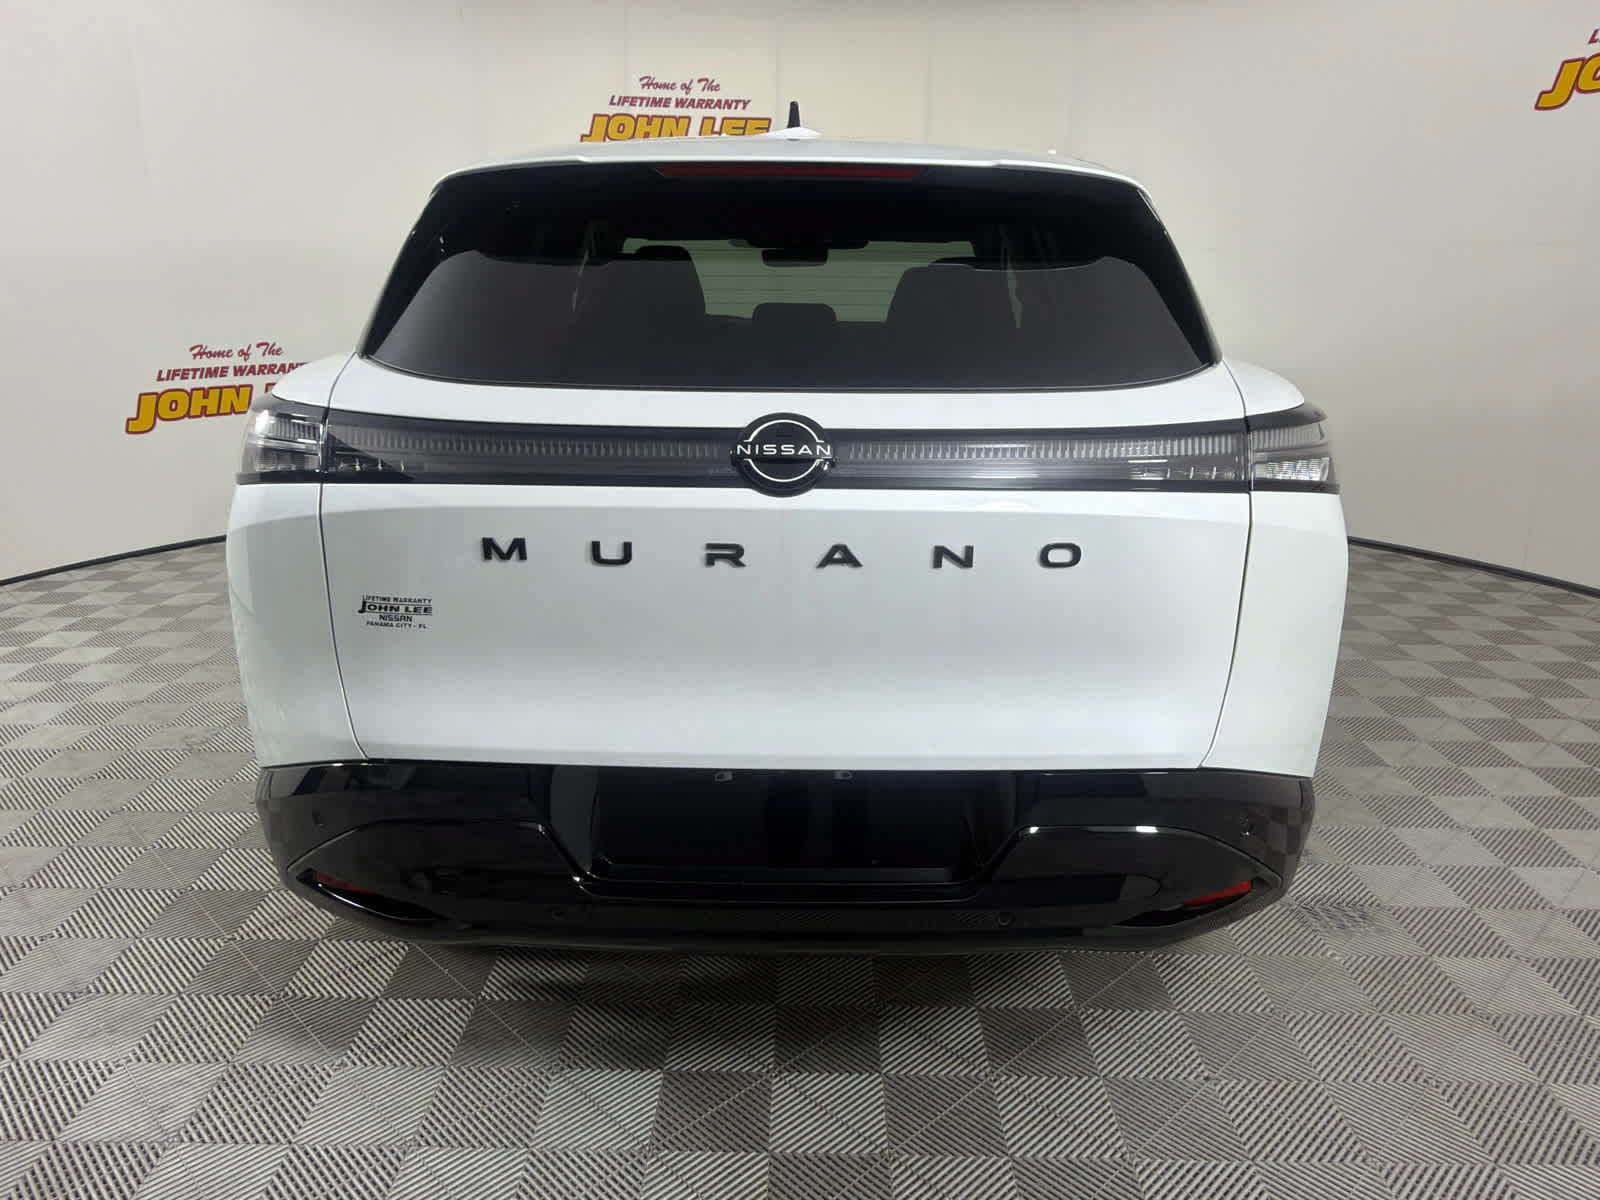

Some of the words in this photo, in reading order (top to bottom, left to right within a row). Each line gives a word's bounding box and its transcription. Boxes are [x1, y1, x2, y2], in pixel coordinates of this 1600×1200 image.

[639, 76, 677, 91] Home
[680, 80, 694, 94] of
[697, 78, 720, 92] The
[609, 95, 672, 107] LIFETIME
[674, 98, 751, 110] WARRANTY
[580, 113, 691, 142] JOHN
[699, 117, 772, 137] LEE
[189, 344, 233, 360] Home
[237, 344, 251, 361] of
[256, 342, 283, 358] The
[156, 367, 229, 382] LIFETIME
[125, 384, 254, 434] JOHN
[736, 444, 831, 456] NISSAN
[481, 536, 1082, 569] MURANO
[358, 600, 400, 613] JOHN
[405, 606, 432, 614] LEE
